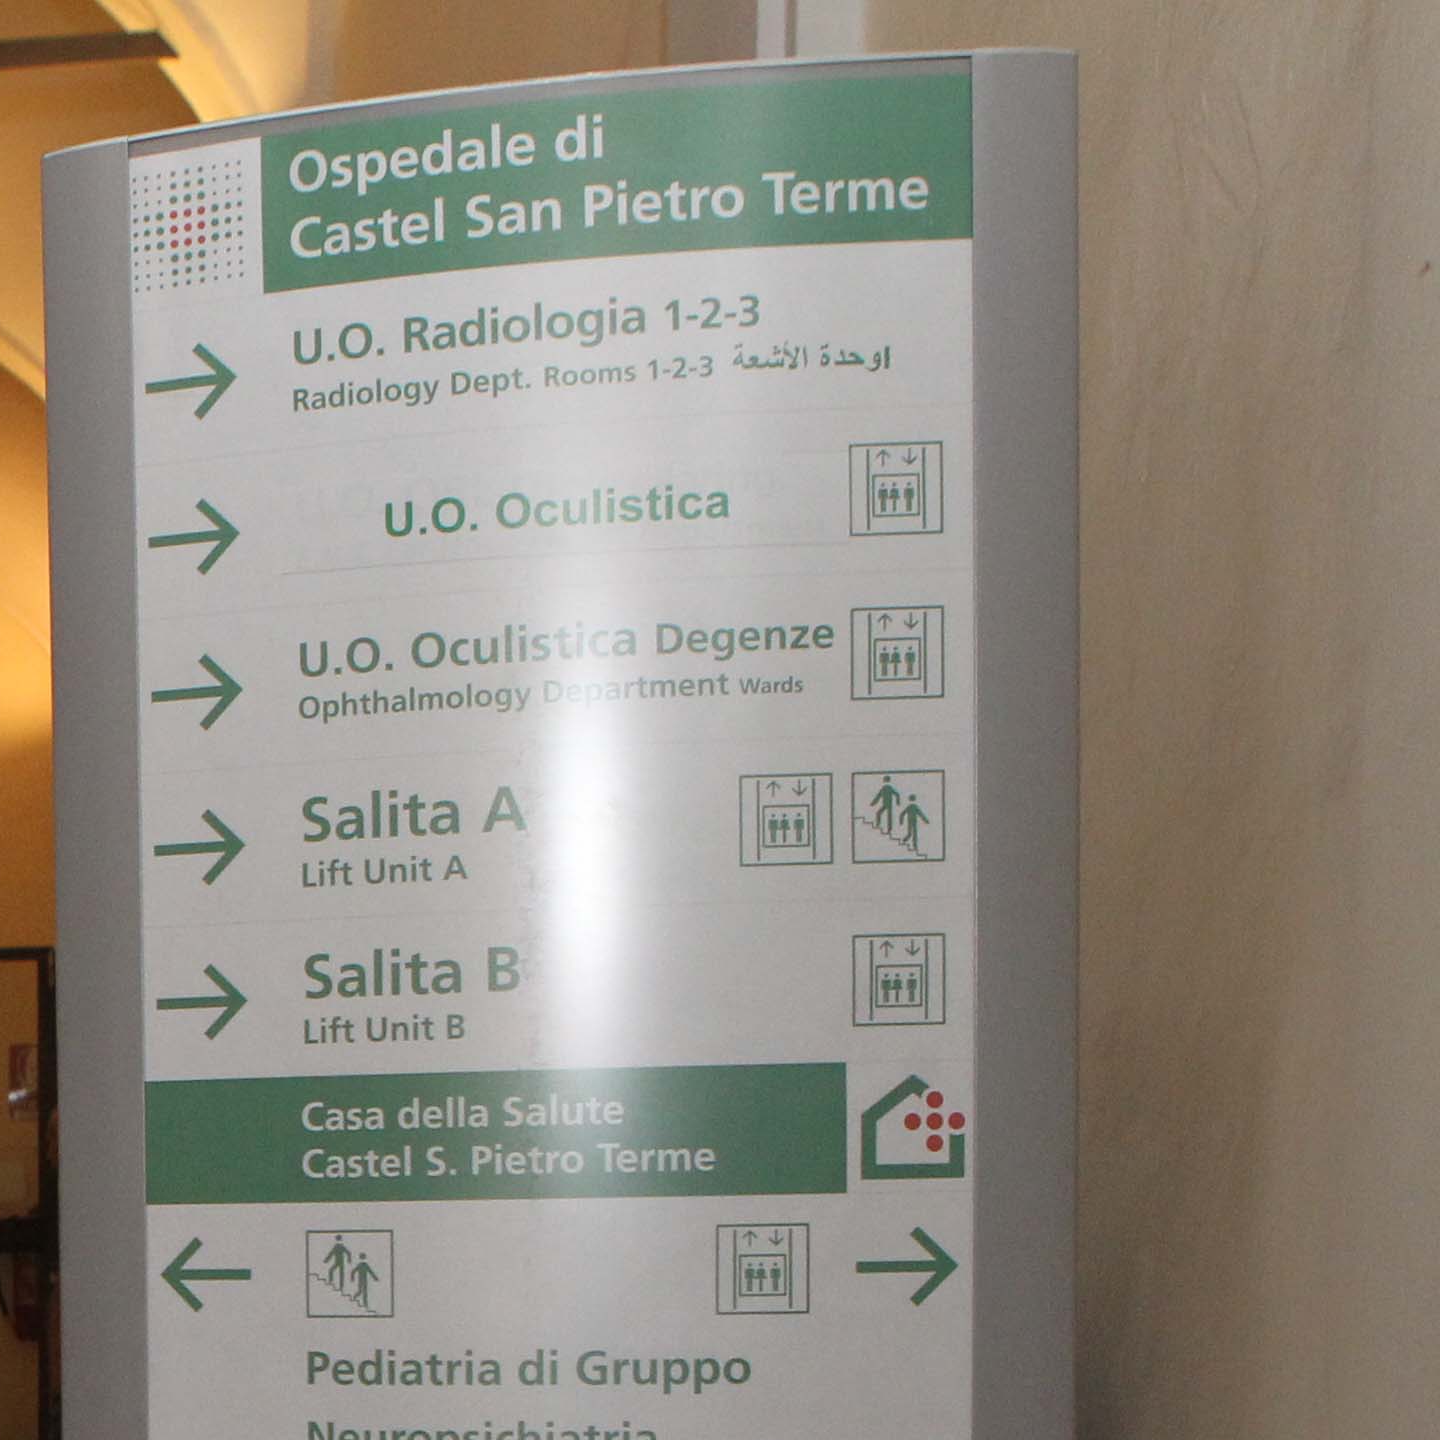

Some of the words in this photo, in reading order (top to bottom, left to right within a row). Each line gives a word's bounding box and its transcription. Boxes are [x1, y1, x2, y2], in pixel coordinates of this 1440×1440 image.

[290, 121, 536, 198] Ospedale
[555, 115, 604, 161] di
[290, 199, 445, 260] Castel
[466, 194, 562, 239] San
[583, 181, 745, 231] Pietro
[762, 168, 928, 216] Terme
[292, 323, 384, 367] U.O.
[403, 299, 645, 354] Radiologia
[664, 294, 760, 334] 1-2-3
[292, 372, 439, 413] Radiology
[450, 366, 530, 399] Dept.
[543, 359, 637, 388] Rooms
[648, 353, 713, 382] 1-2-3
[384, 497, 478, 538] U.O.
[496, 485, 730, 531] Oculistica
[298, 638, 393, 677] U.O.
[411, 623, 637, 669] Oculistica
[655, 619, 834, 660] Degenze
[298, 682, 531, 720] Ophthalmology
[542, 673, 729, 706] Department
[739, 674, 804, 696] Wards
[302, 791, 459, 842] Salita
[483, 786, 527, 831] A
[302, 858, 353, 888] Lift
[364, 855, 431, 885] Unit
[444, 858, 467, 881] A
[303, 952, 462, 998] Salita
[488, 947, 520, 991] B
[303, 1016, 355, 1045] Lift
[366, 1014, 434, 1043] Unit
[446, 1015, 466, 1040] B
[302, 1102, 384, 1133] Casa
[397, 1097, 488, 1129] della
[502, 1095, 624, 1126] Salute
[302, 1145, 412, 1180] Castel
[425, 1146, 458, 1177] S.
[471, 1142, 584, 1176] Pietro
[597, 1142, 716, 1174] Terme
[306, 1351, 502, 1386] Pediatria
[519, 1348, 559, 1386] di
[576, 1351, 751, 1394] Gruppo
